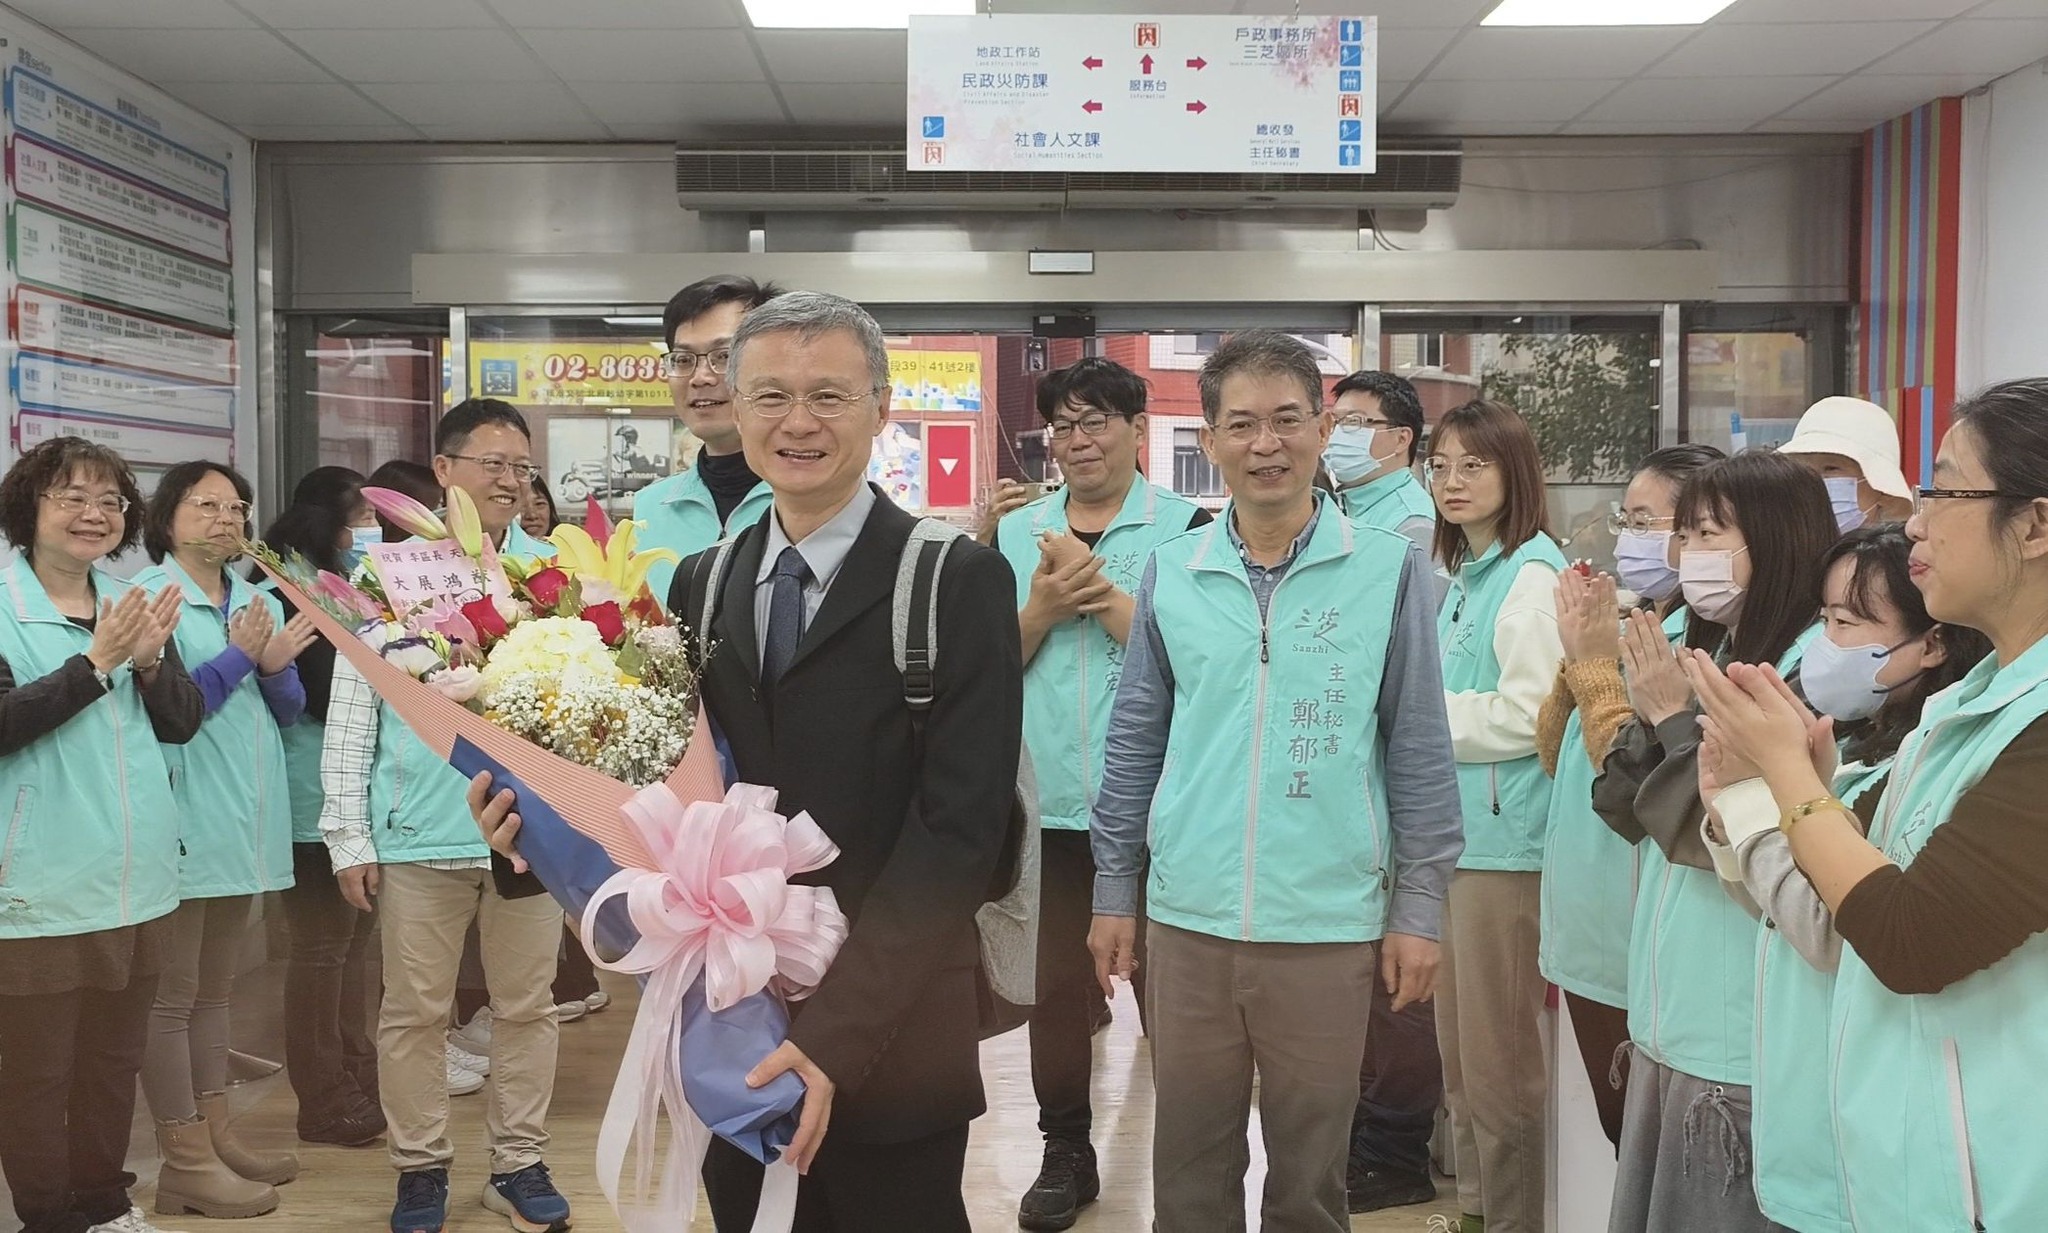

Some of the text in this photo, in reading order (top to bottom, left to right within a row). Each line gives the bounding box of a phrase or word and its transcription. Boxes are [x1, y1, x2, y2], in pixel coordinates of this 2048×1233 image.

[1235, 27, 1316, 42] 戶政事務所
[976, 46, 1040, 58] 地政工作站
[962, 73, 1048, 89] 民政災防課
[1129, 79, 1167, 92] 服務台
[1256, 124, 1294, 136] 總收發
[1014, 132, 1101, 148] 社會人文課
[450, 547, 467, 559] 天
[1292, 643, 1329, 654] Sanzhi
[1323, 663, 1347, 757] 主任秘書
[1286, 698, 1322, 799] 鄭郁正
